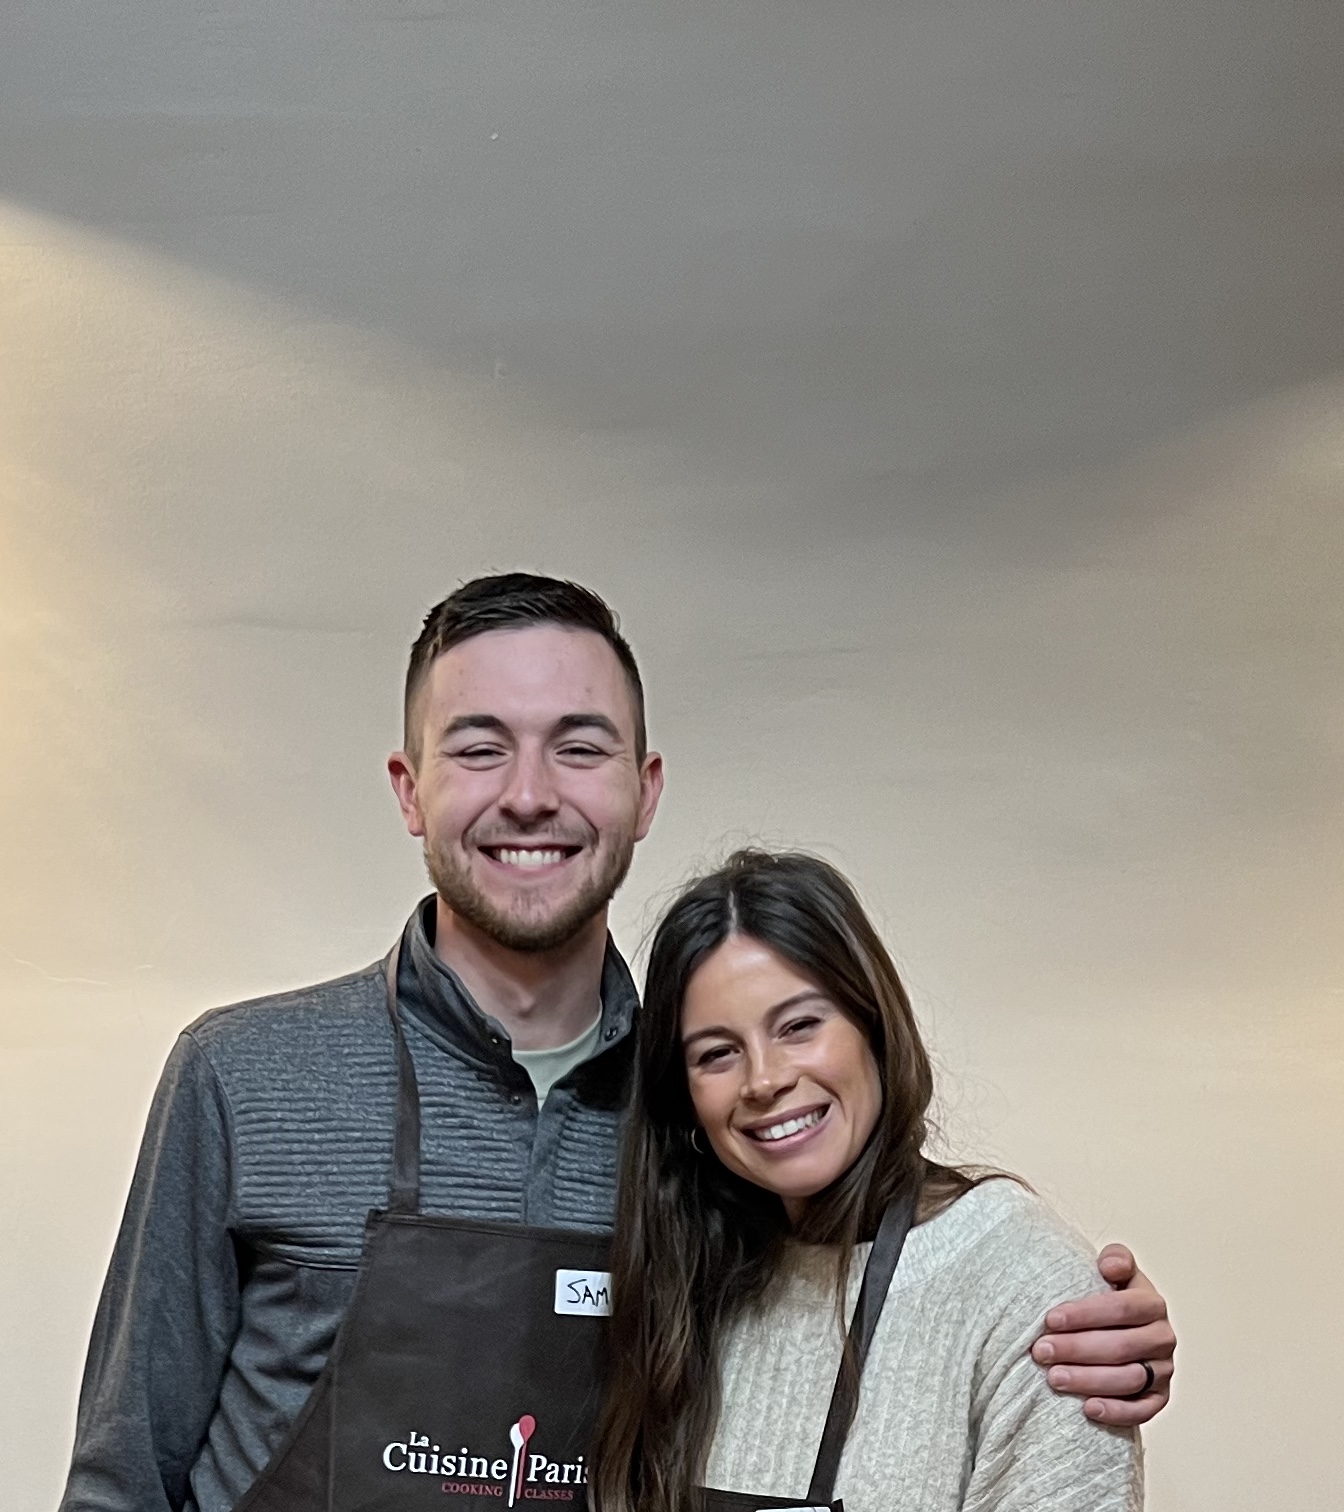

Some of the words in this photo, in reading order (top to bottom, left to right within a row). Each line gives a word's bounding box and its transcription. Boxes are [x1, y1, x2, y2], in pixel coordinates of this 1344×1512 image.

[566, 1278, 608, 1307] SAM
[410, 1431, 430, 1447] La
[382, 1442, 508, 1480] Cuisine
[441, 1481, 503, 1497] COOKING
[524, 1488, 574, 1500] CLASSES
